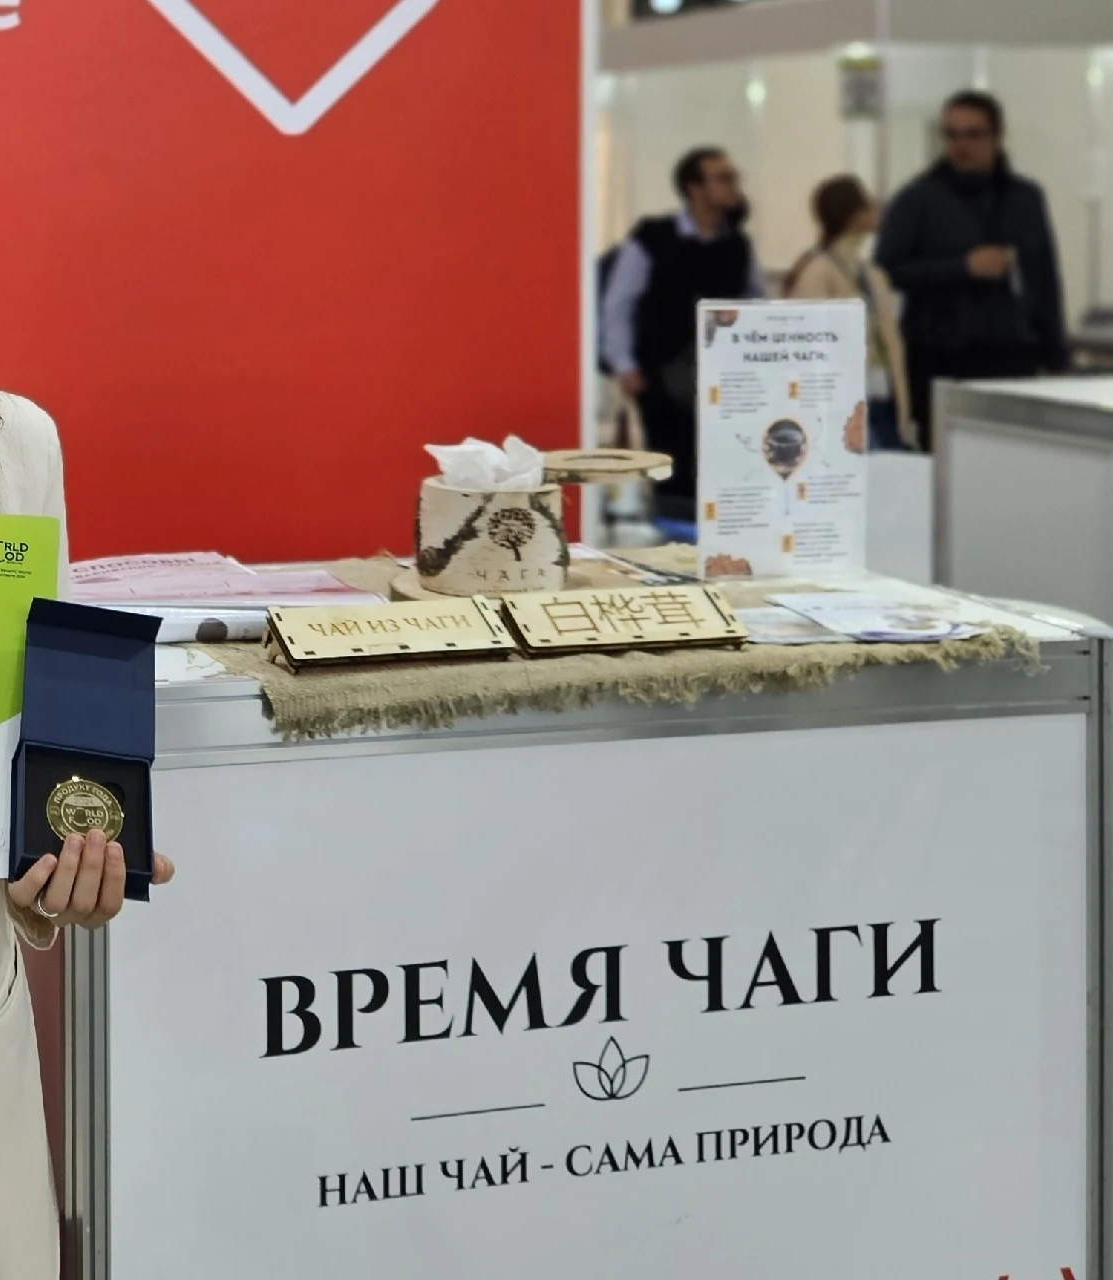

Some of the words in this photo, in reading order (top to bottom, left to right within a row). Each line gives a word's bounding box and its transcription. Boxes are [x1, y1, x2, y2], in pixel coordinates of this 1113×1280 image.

[307, 618, 364, 638] ЧАЙ
[370, 616, 401, 634] ИЗ
[403, 612, 473, 632] ЧАГИ
[541, 590, 706, 636] 白桦茸
[259, 944, 629, 1059] ВРЕМЯ
[662, 917, 944, 1014] ЧАГИ
[317, 1162, 426, 1209] НАШ
[438, 1144, 531, 1196] ЧАЙ
[565, 1135, 685, 1178] САМА
[696, 1111, 892, 1166] ПРИРОДА
